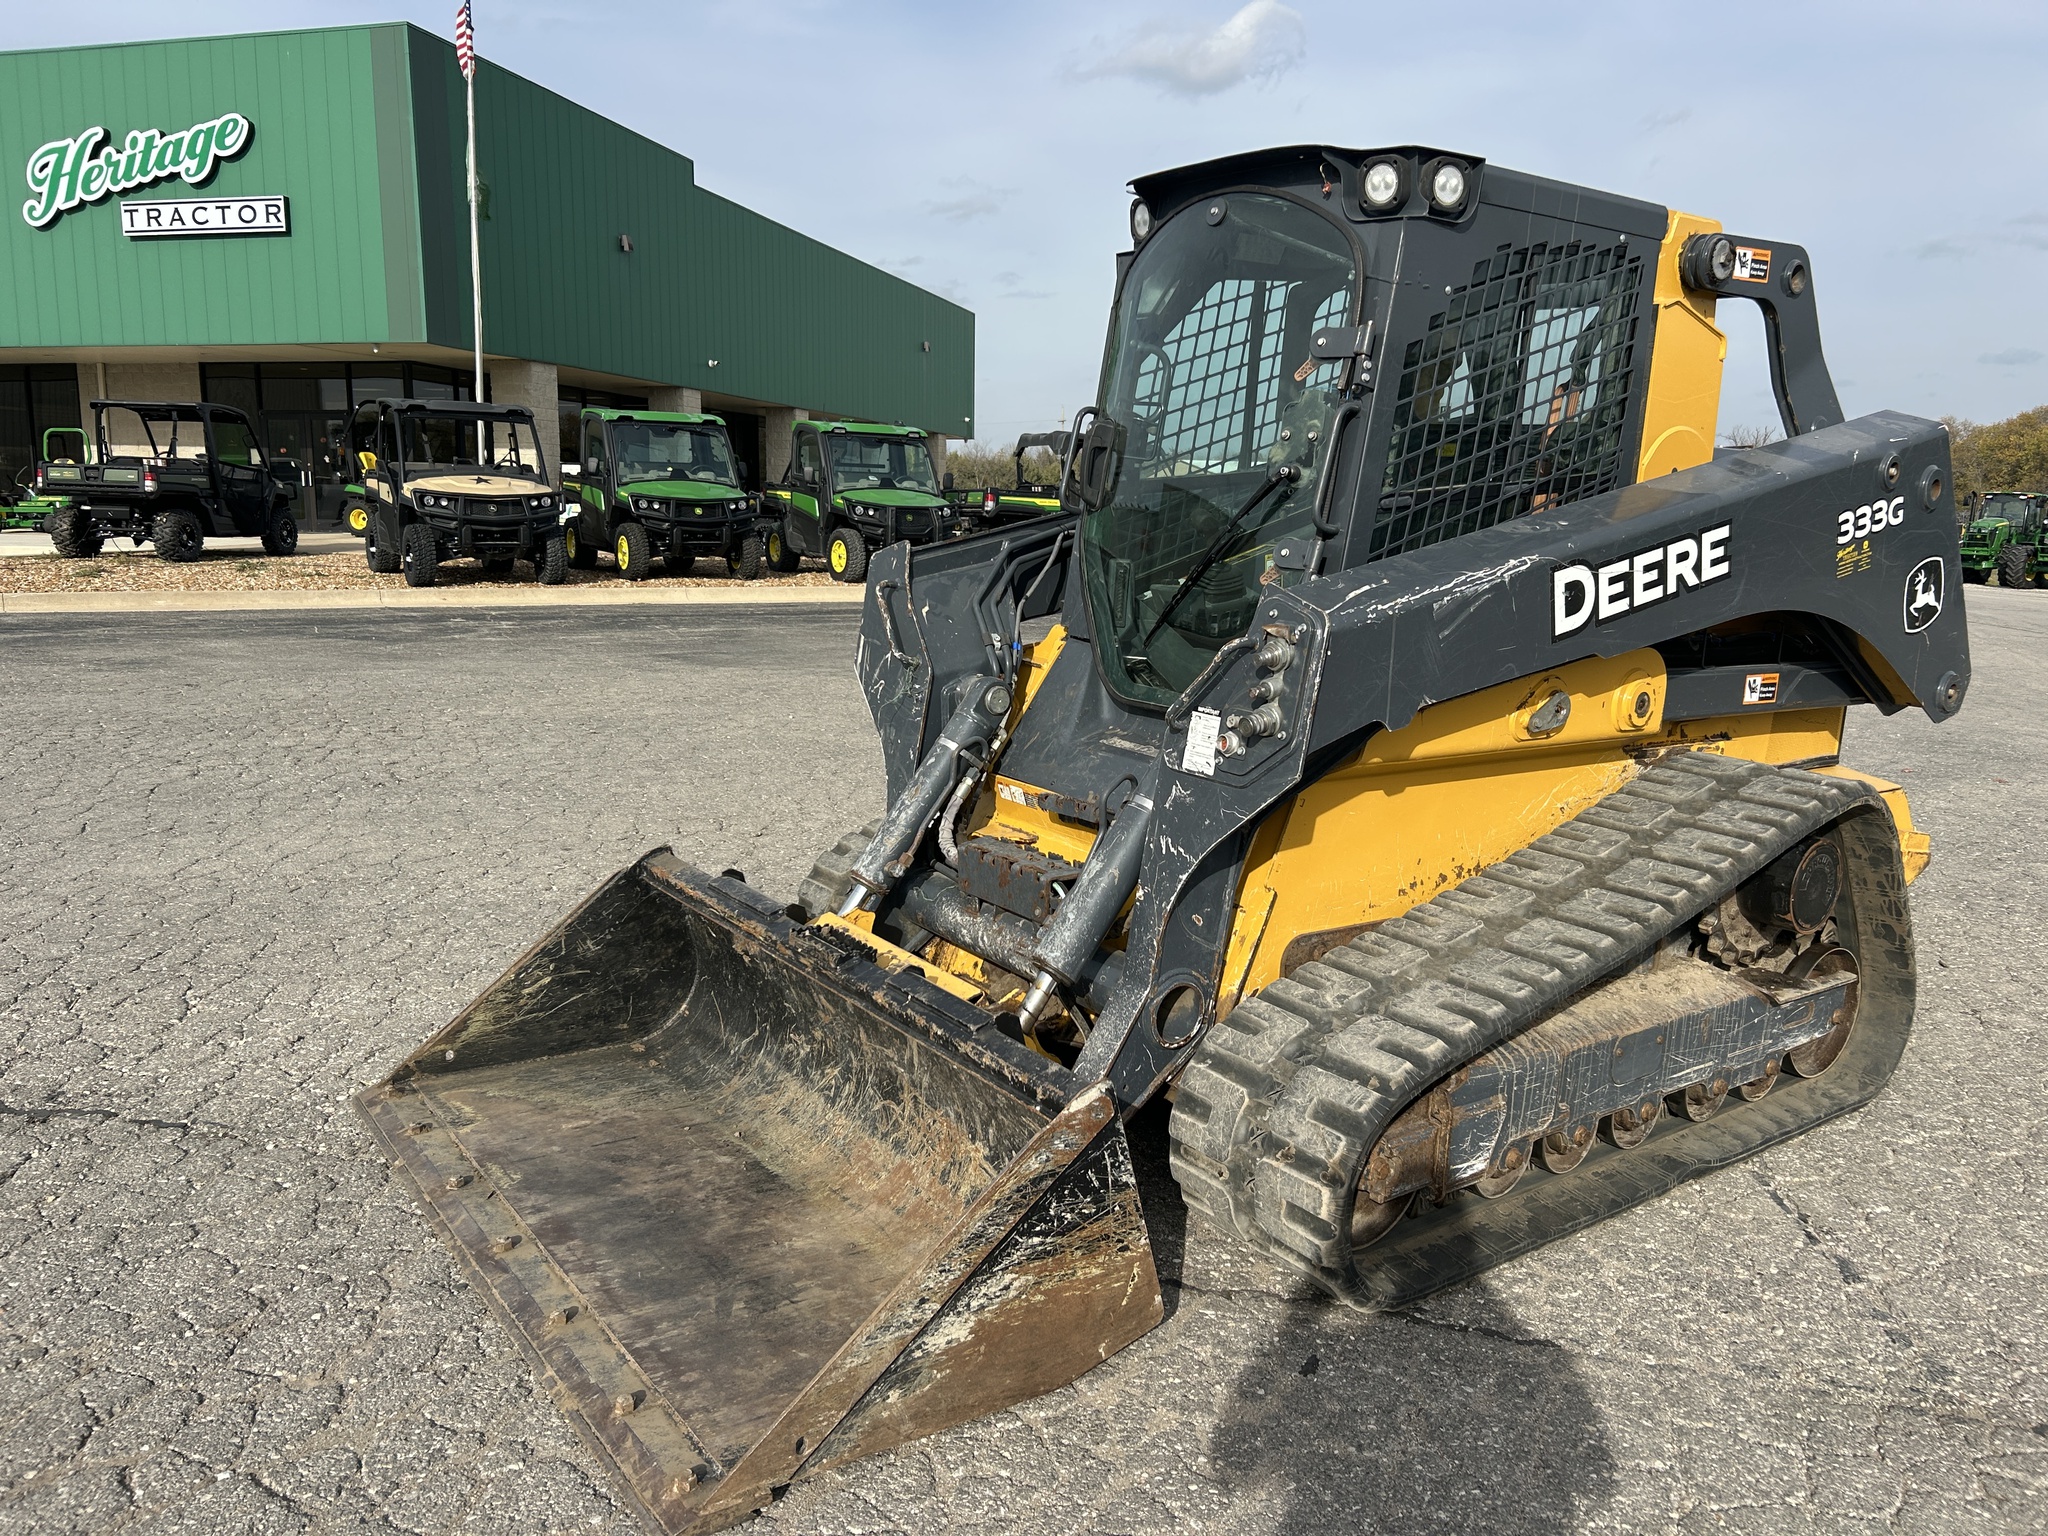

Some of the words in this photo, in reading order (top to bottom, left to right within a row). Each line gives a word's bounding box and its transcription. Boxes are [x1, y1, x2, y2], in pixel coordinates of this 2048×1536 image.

[25, 114, 247, 224] Heritage
[124, 203, 283, 228] TRACTOR
[1836, 496, 1905, 544] 333G
[1554, 524, 1731, 636] DEERE
